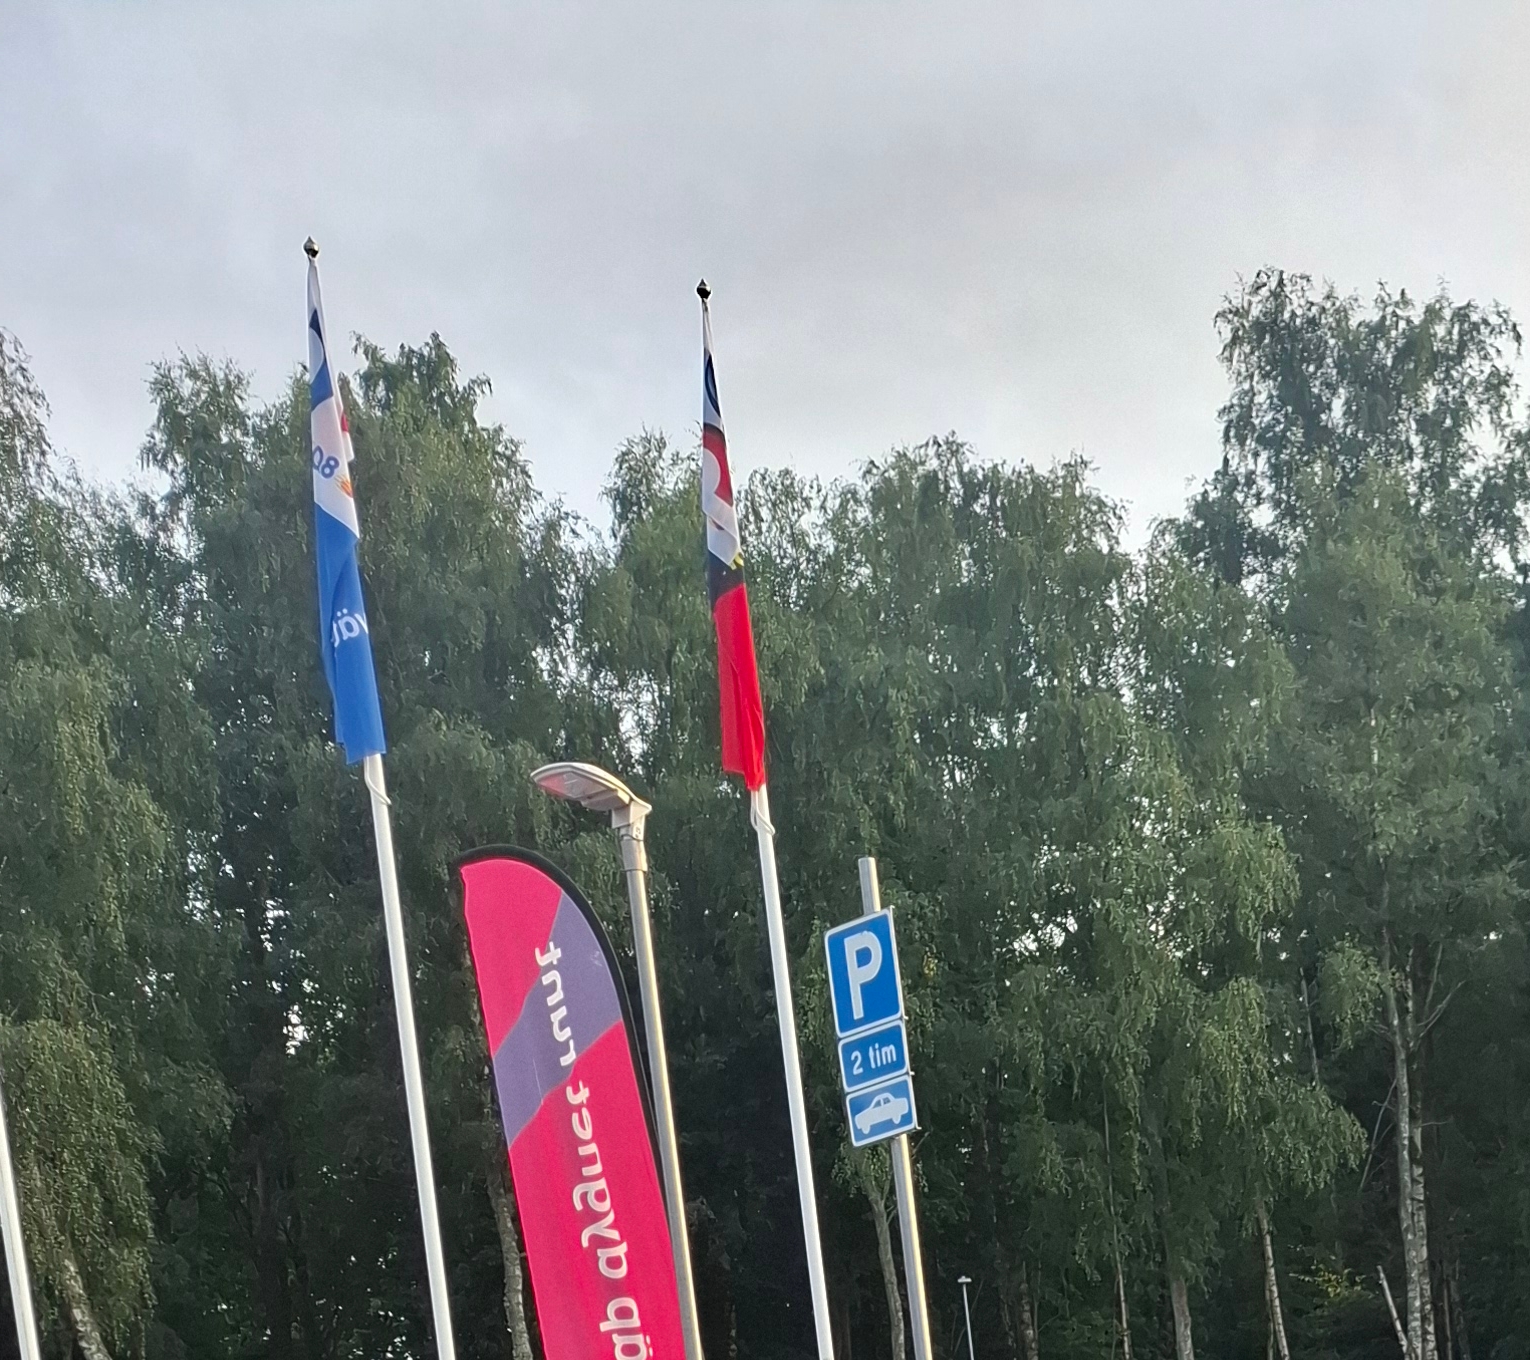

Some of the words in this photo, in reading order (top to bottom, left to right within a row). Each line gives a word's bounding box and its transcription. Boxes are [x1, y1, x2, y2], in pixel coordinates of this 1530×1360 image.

[845, 930, 882, 1019] P
[851, 1054, 865, 1074] 2
[868, 1042, 897, 1070] tim
